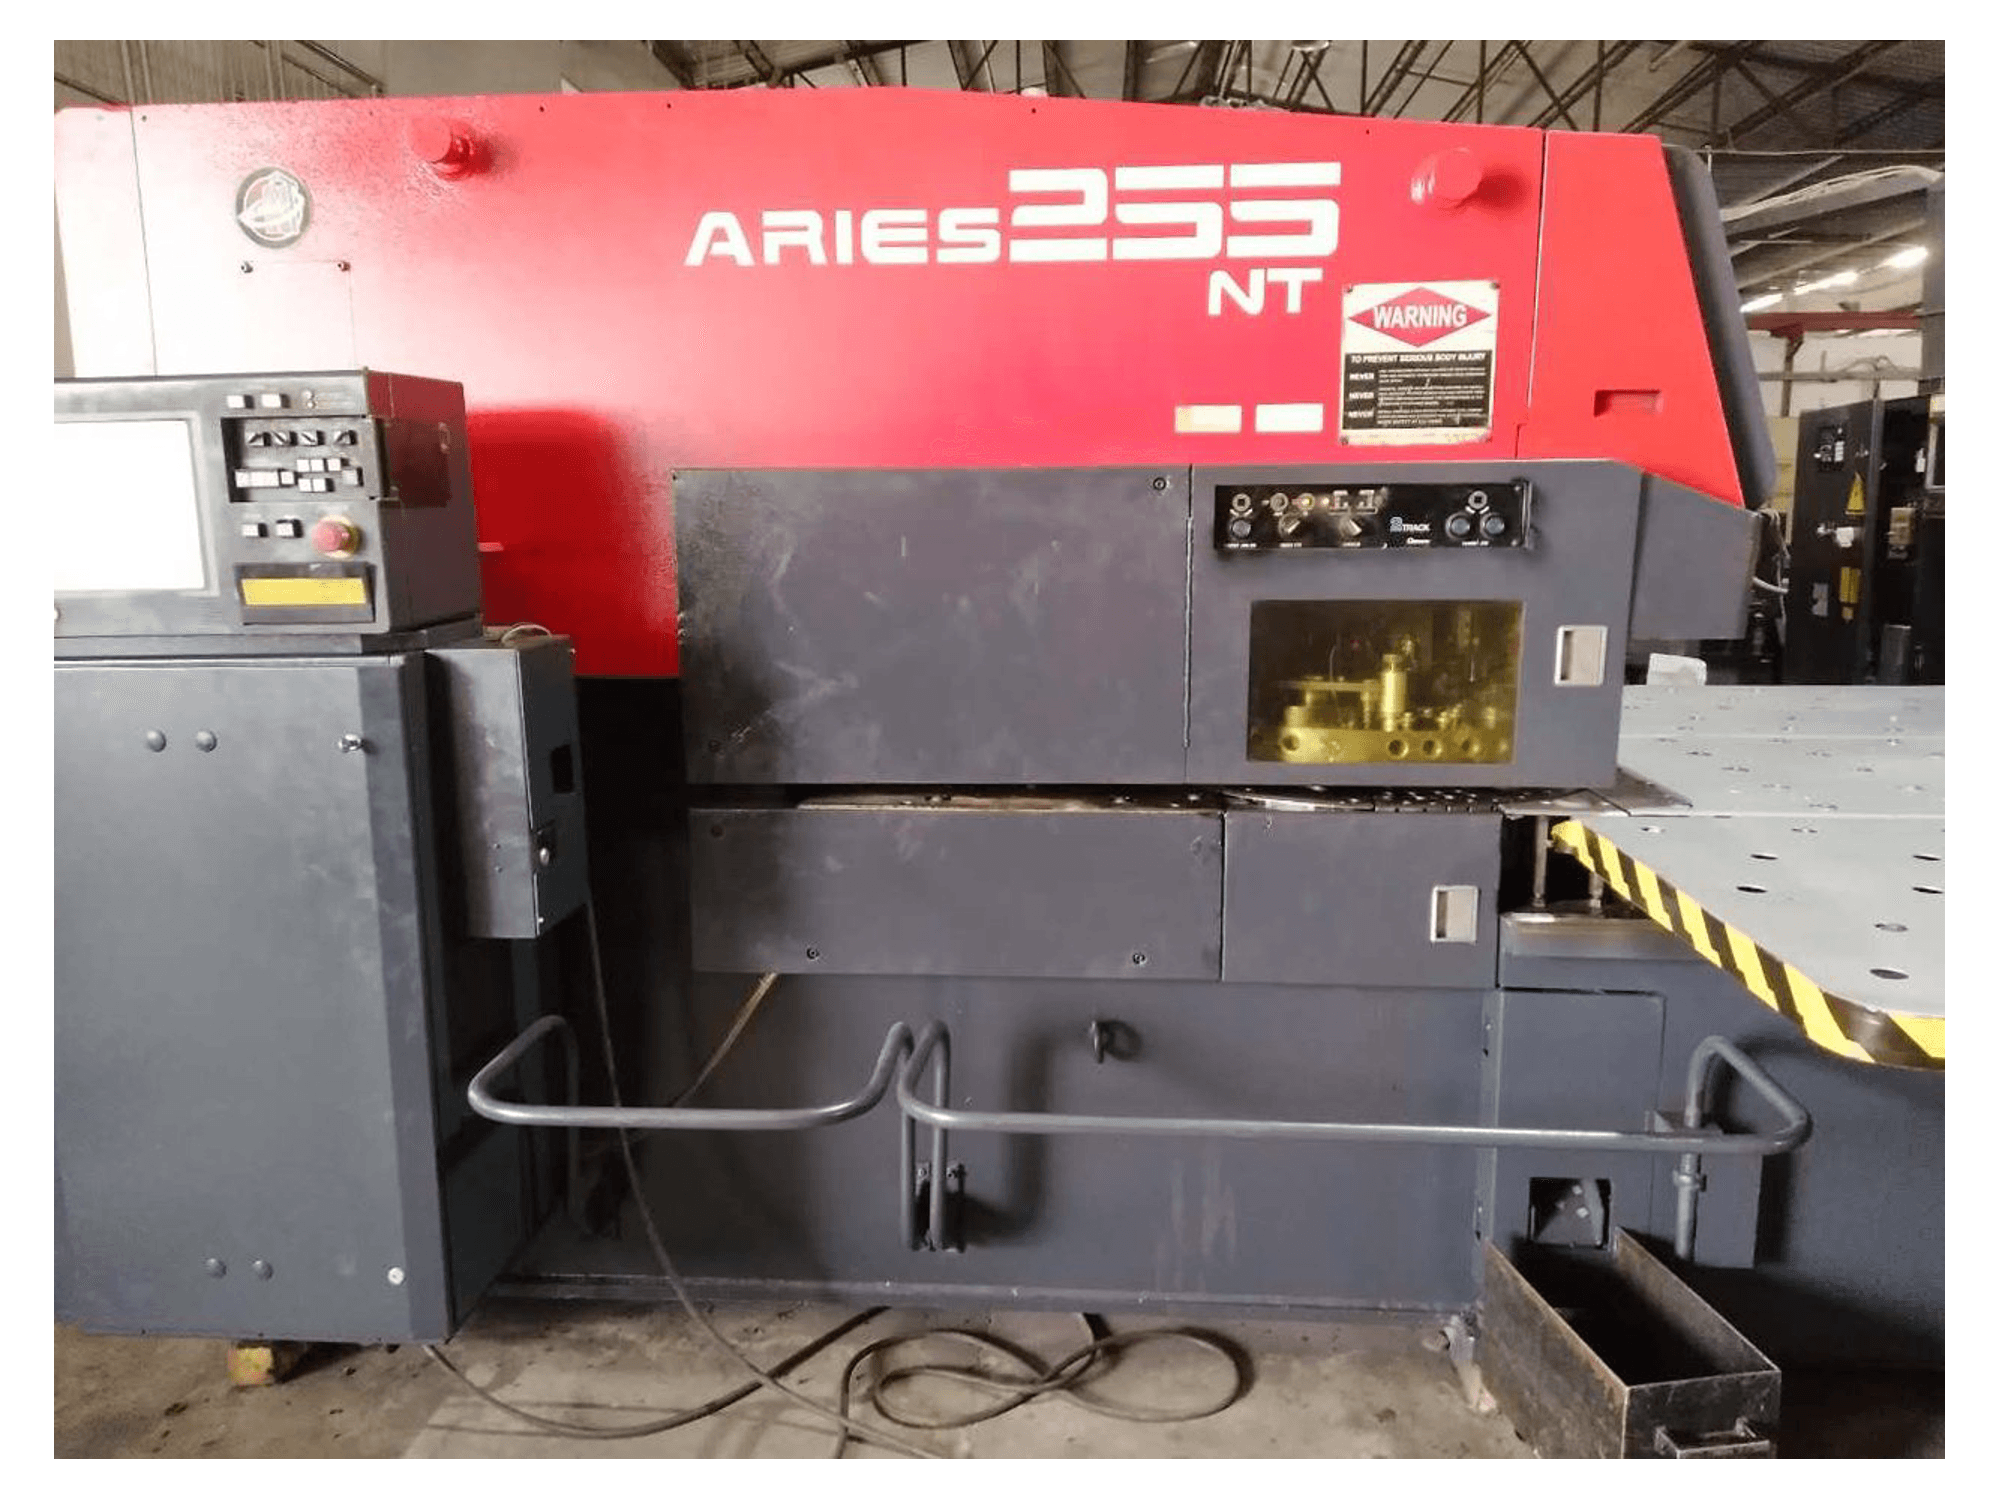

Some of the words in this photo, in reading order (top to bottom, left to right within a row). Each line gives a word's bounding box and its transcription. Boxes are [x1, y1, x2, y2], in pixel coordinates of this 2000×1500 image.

[684, 208, 1001, 266] ARIES
[1008, 161, 1342, 262] 255
[1207, 267, 1323, 317] NT
[1373, 303, 1468, 329] WARNING
[1350, 355, 1361, 364] TO
[1362, 354, 1398, 363] PREVENT
[1434, 353, 1456, 361] BODY
